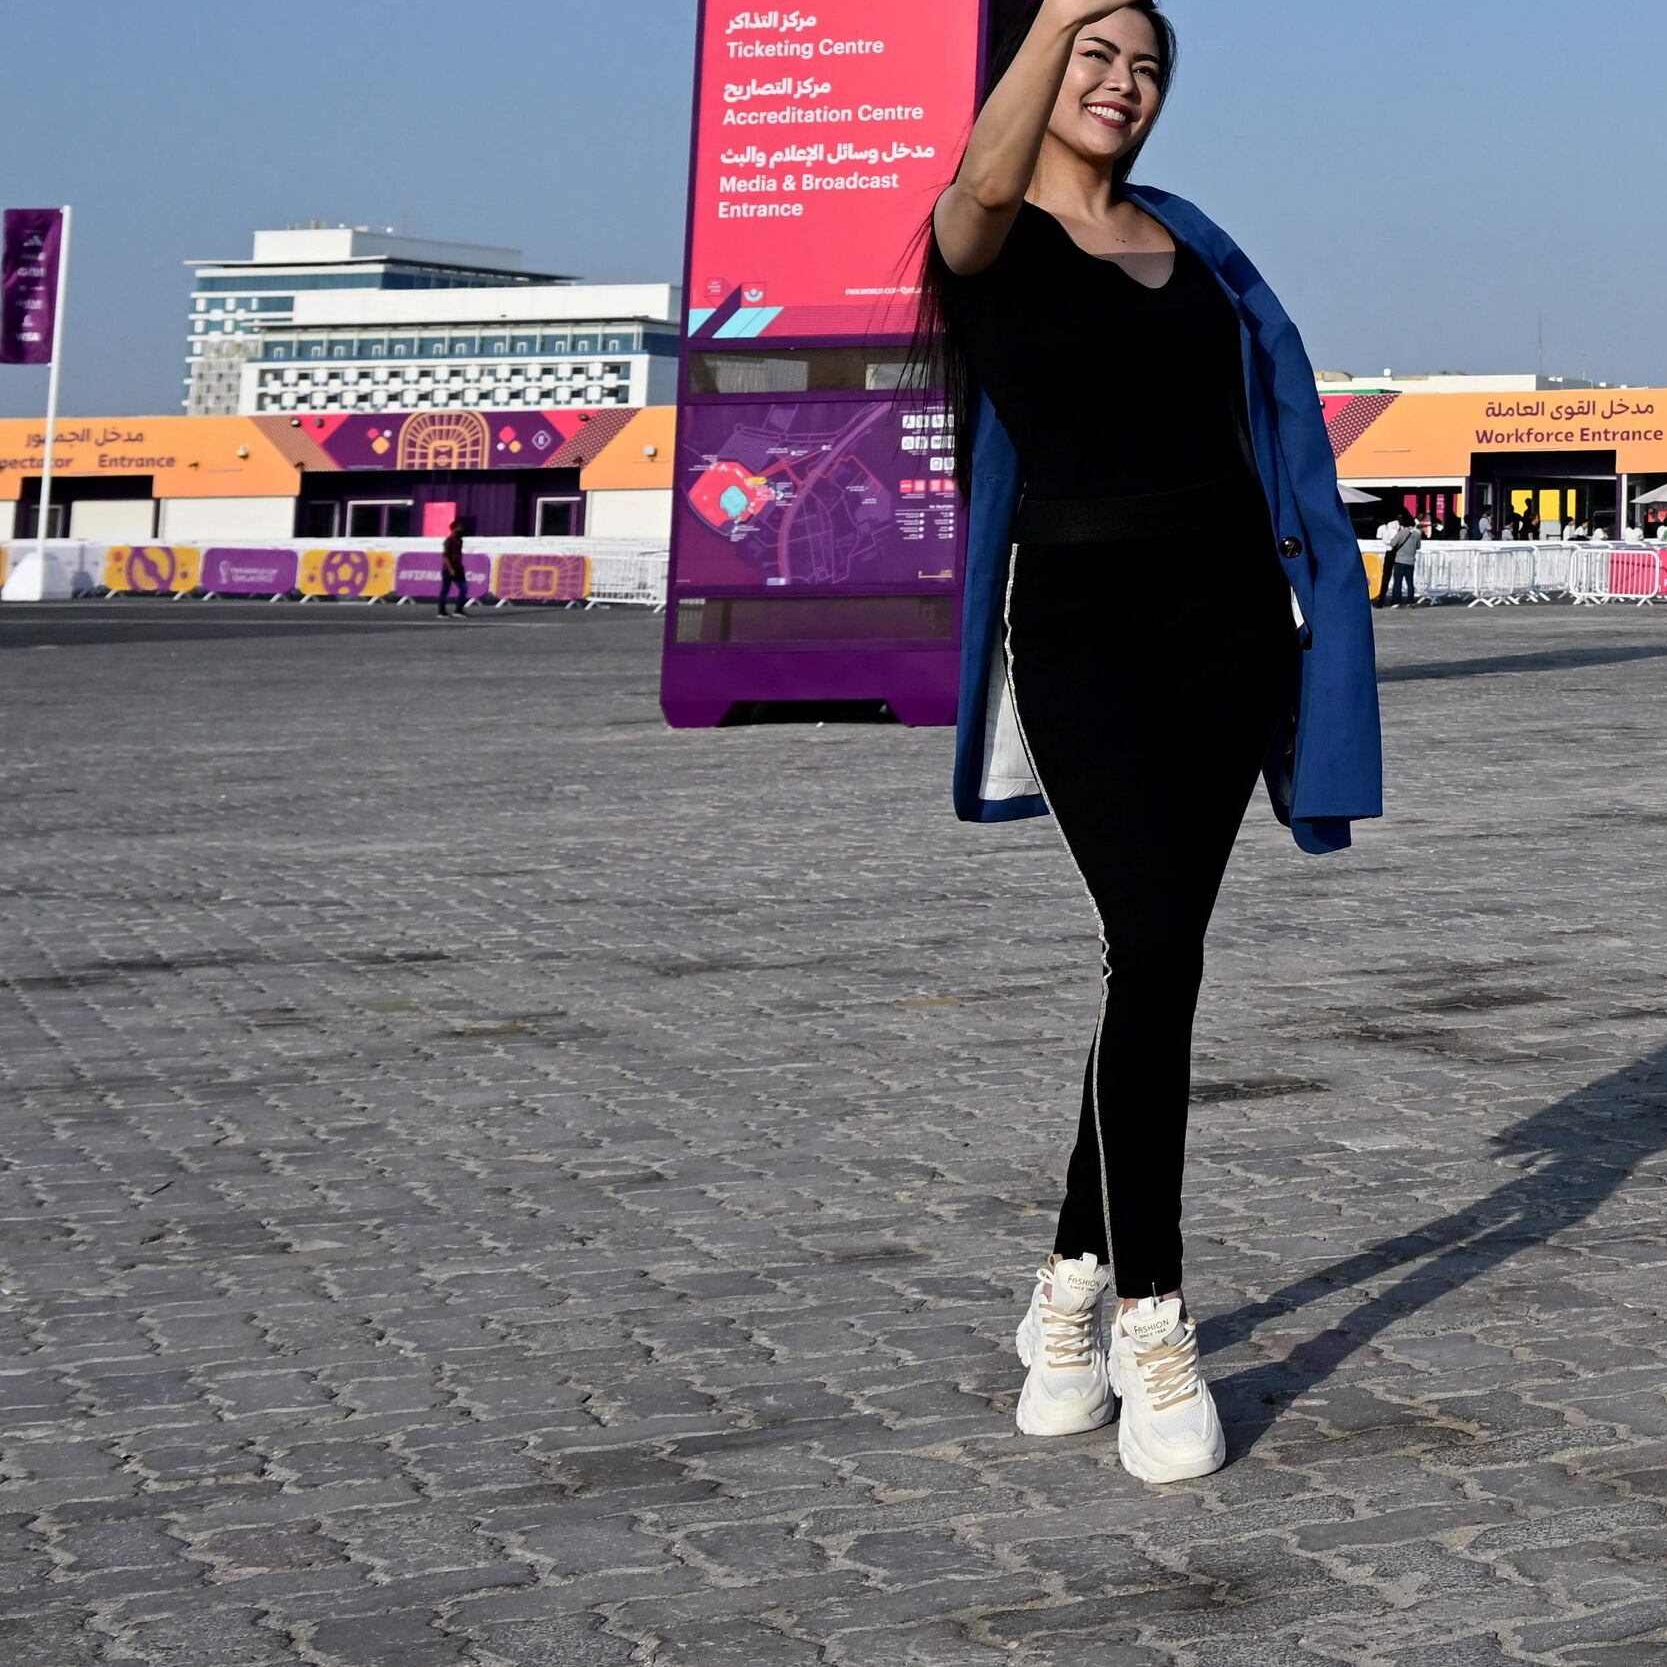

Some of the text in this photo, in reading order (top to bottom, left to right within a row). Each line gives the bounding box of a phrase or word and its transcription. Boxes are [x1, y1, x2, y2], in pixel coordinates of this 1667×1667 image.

[725, 10, 817, 34] مركز التذاكر
[726, 38, 884, 60] Ticketing Centre
[723, 77, 831, 103] مركز التصاريح
[722, 104, 924, 125] Accreditation Centre
[720, 141, 935, 168] مدخل وسائل الإعلام والبث
[719, 172, 899, 193] Media & Broadcast
[718, 202, 804, 218] Entrance
[1485, 398, 1654, 421] مدخل القوى العاملة
[25, 427, 144, 448] مدخل الجمور
[1475, 427, 1664, 444] Workforce Entrance
[98, 454, 175, 468] Entrance
[1133, 1318, 1169, 1335] FASHION
